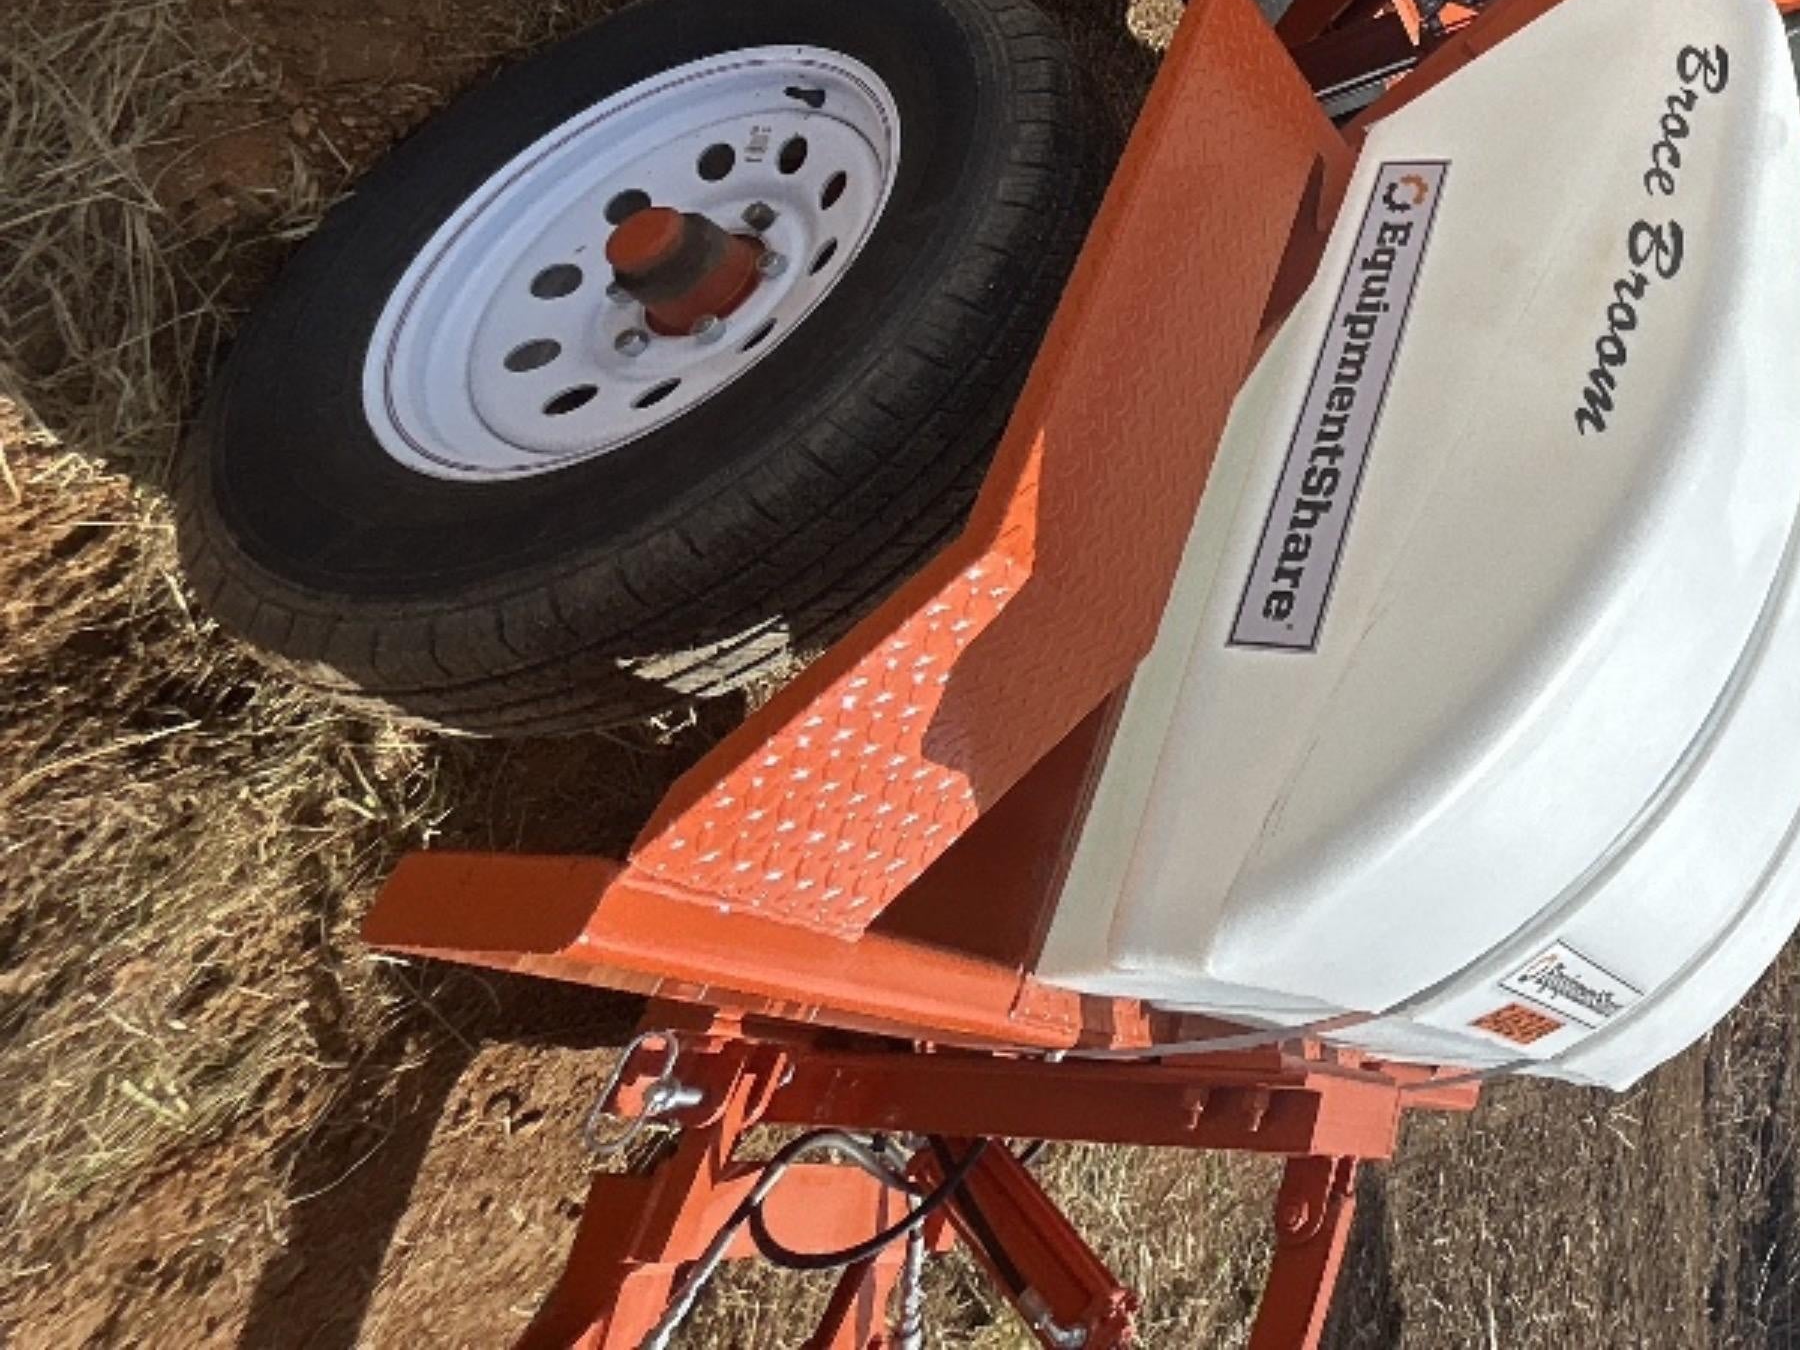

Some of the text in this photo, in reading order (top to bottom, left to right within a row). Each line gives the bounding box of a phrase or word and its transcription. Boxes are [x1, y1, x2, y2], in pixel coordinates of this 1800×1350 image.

[1262, 221, 1415, 622] EquipmentShare
[1575, 43, 1730, 437] Broce Broom
